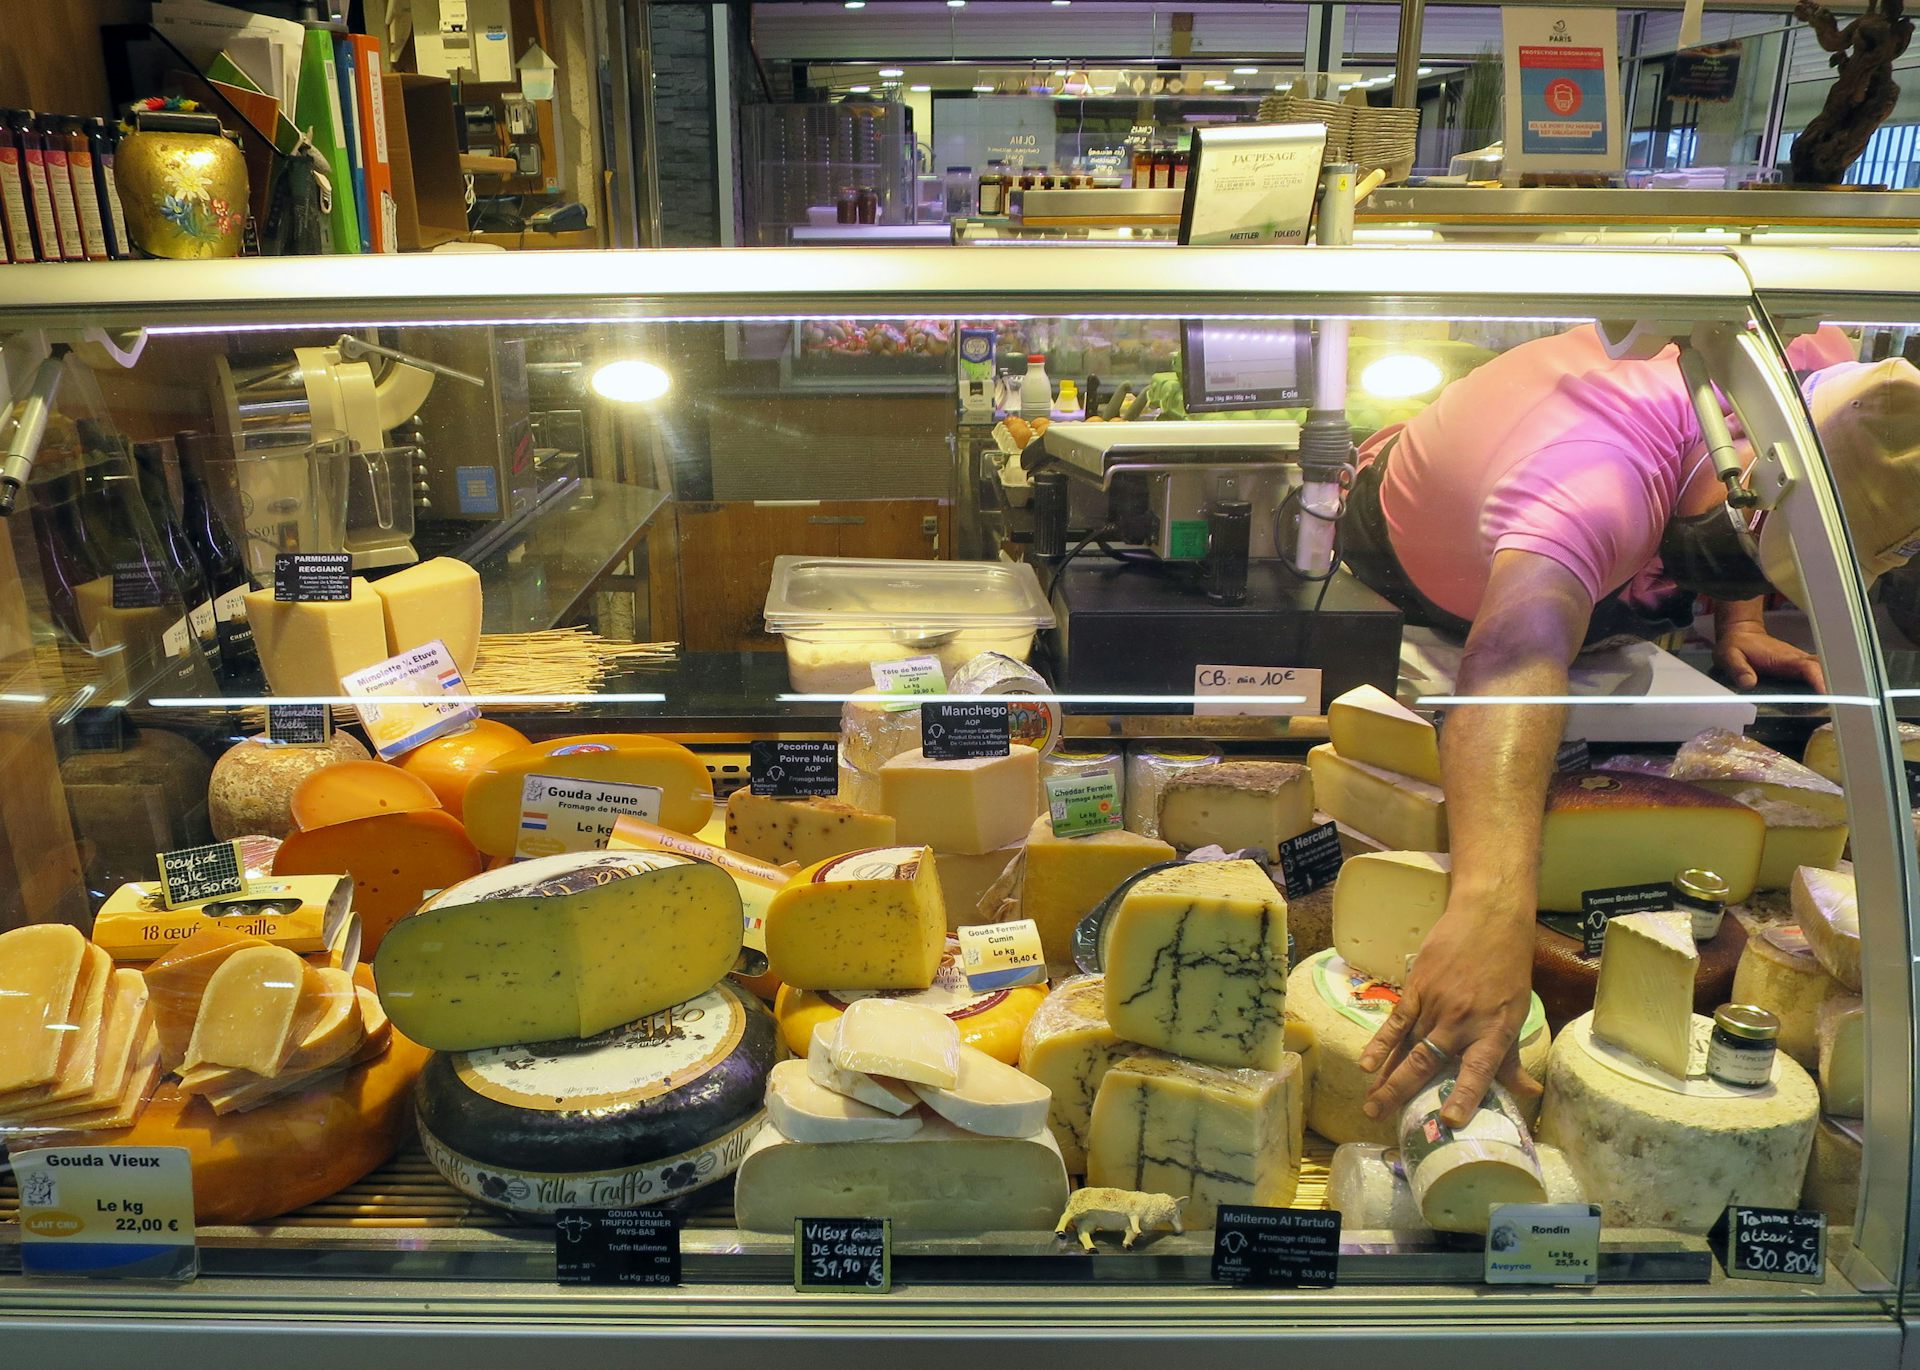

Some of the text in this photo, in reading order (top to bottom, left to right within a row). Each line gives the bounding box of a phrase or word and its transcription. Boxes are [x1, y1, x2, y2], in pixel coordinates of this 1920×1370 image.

[1230, 230, 1301, 240] METTLER TOLEDO
[294, 555, 349, 564] PARMIGIANO
[911, 664, 933, 673] Moine
[357, 664, 402, 687] Mimolette
[366, 677, 398, 694] Fromage
[408, 658, 439, 675] Hollande
[1236, 675, 1256, 684] min
[1260, 669, 1296, 686] 10€
[941, 704, 1007, 718] Manchego
[777, 742, 836, 751] Pecorino Au
[780, 754, 833, 763] Poivre Noir
[804, 765, 821, 773] AOP
[788, 775, 815, 783] Fromage
[548, 786, 638, 806] Gouda Jeune
[1054, 784, 1113, 797] Cheddar Fermier
[558, 801, 596, 812] Fromage
[610, 807, 648, 817] Hollande
[576, 822, 593, 833] Le
[1294, 825, 1334, 850] Hercule
[168, 870, 208, 887] caille
[1589, 890, 1668, 906] Tomme Brebis Papillon
[141, 925, 160, 941] 18
[968, 924, 1027, 937] Gouda Fermier
[988, 935, 1014, 944] Cumin
[1005, 948, 1015, 956] kg
[1009, 955, 1031, 964] 18,40
[46, 1154, 160, 1168] Gouda Vieux
[536, 1170, 653, 1205] Villa Truffo
[97, 1199, 144, 1214] Le kg
[608, 1210, 664, 1218] GOUDA VILLA
[31, 1221, 54, 1229] LAIT
[115, 1218, 179, 1234] 22,00 €
[601, 1219, 671, 1227] TRUFFO FERMIER
[1223, 1212, 1335, 1229] Moliterno Al Tartufo
[616, 1228, 656, 1236] PAYS-BAS
[805, 1224, 849, 1241] VIEUX
[1531, 1225, 1570, 1235] Rondin
[1258, 1233, 1326, 1244] Fromage d'Italie
[608, 1243, 668, 1251] Truffe Italienne
[811, 1243, 831, 1256] DE
[1549, 1250, 1574, 1259] Le kg
[1224, 1256, 1242, 1265] Lait
[1555, 1258, 1589, 1268] 25,50 €
[811, 1257, 861, 1279] 39,90
[1490, 1262, 1532, 1272] Aveyron
[1301, 1269, 1327, 1279] 53,00
